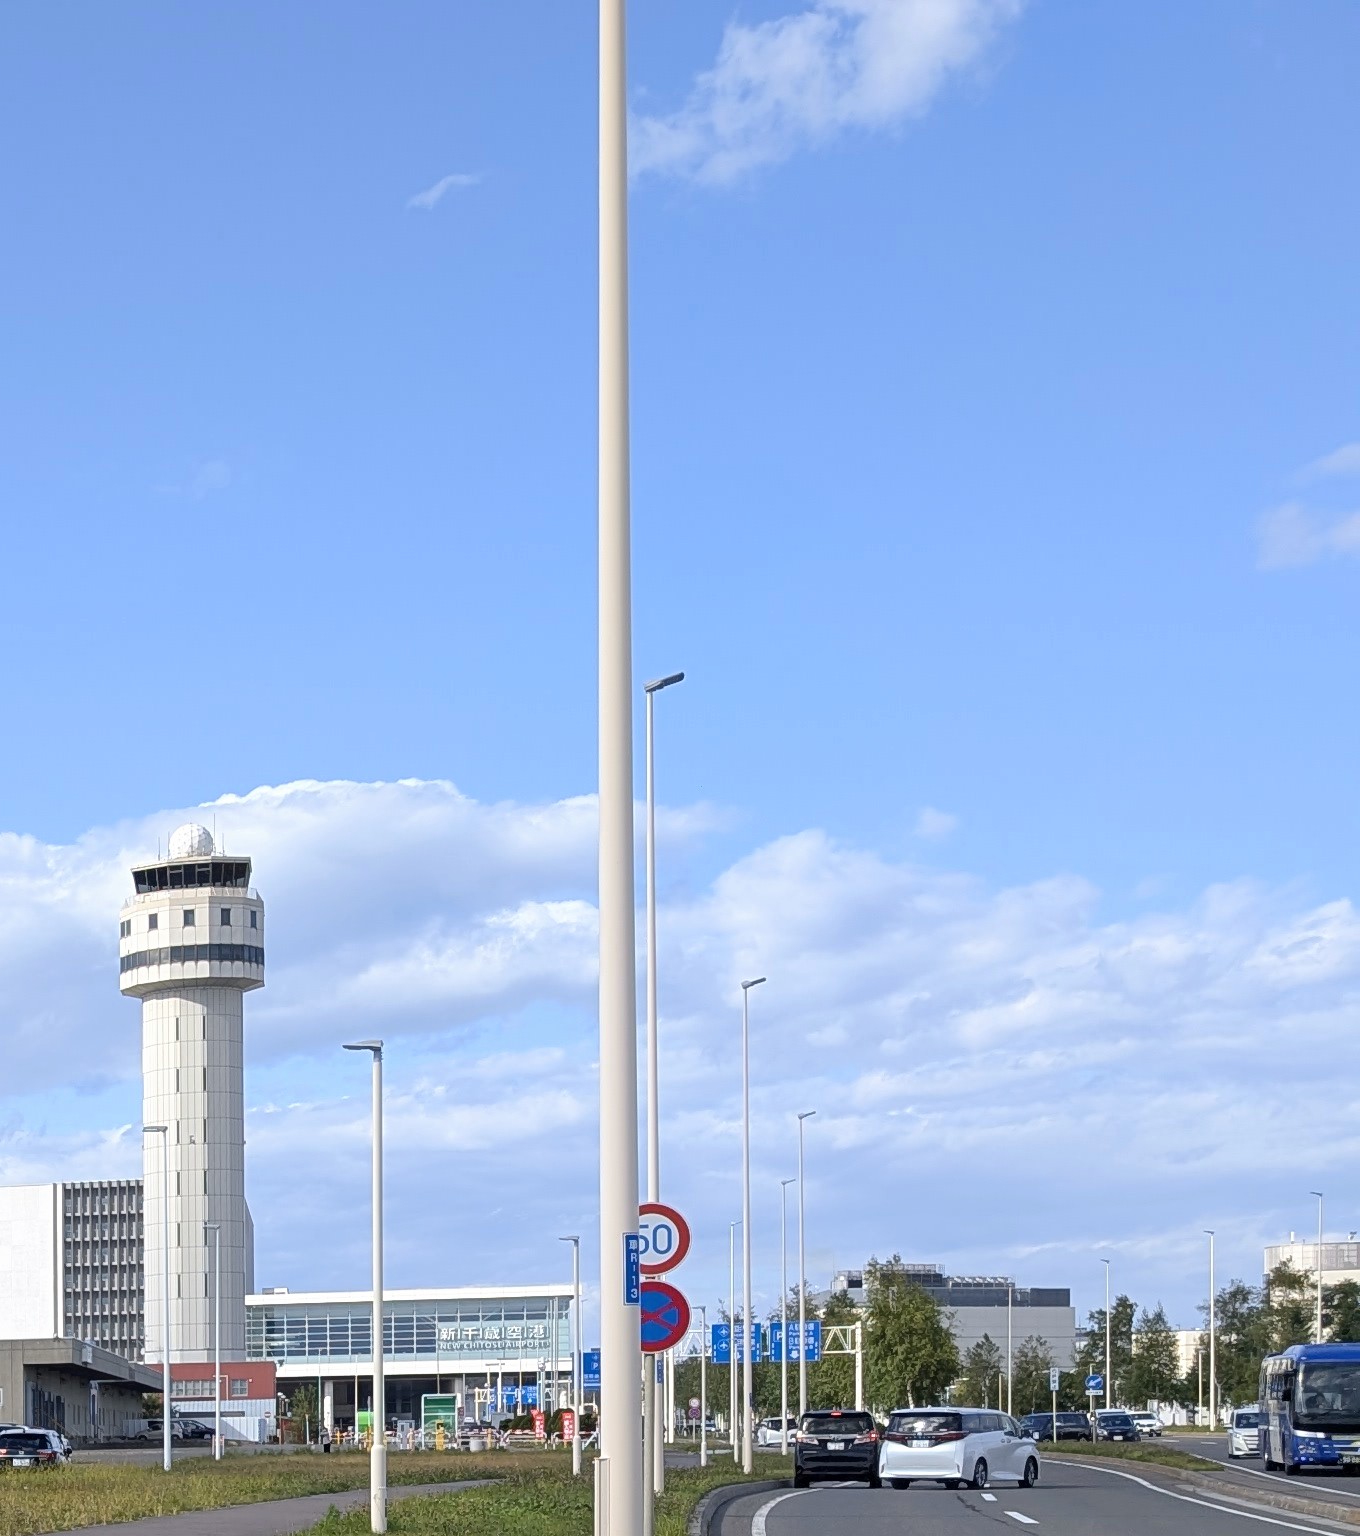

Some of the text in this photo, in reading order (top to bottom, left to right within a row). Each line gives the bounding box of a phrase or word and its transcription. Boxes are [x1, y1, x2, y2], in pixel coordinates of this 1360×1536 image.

[440, 1325, 545, 1340] 新千歳空港
[440, 1341, 460, 1350] NEW
[506, 1340, 545, 1348] AIRPORT
